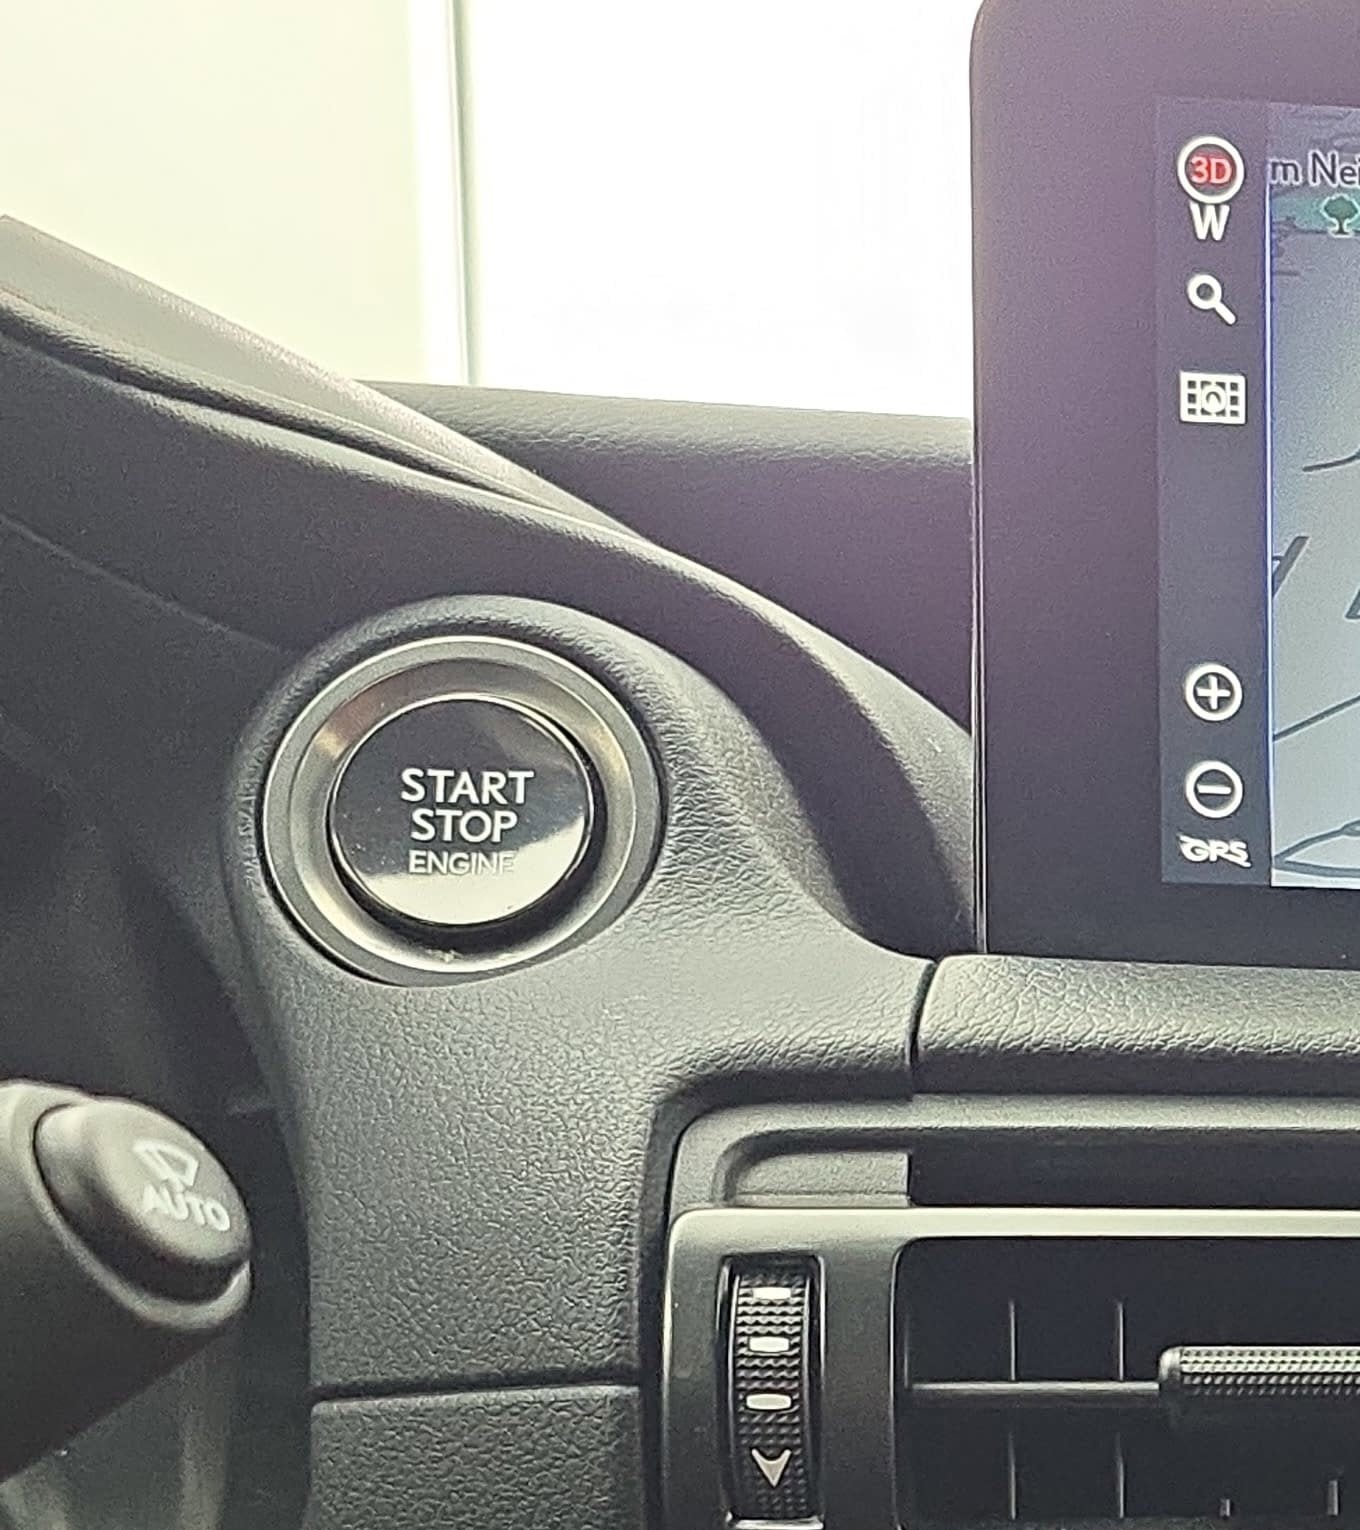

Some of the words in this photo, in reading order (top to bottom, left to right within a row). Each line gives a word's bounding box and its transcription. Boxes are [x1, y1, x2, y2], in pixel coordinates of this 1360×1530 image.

[1189, 156, 1232, 184] 3D
[1271, 160, 1299, 183] m
[1190, 203, 1230, 240] W
[400, 768, 536, 805] START
[411, 808, 518, 843] STOP
[408, 850, 515, 875] ENGINE
[139, 1183, 231, 1233] AUTO
